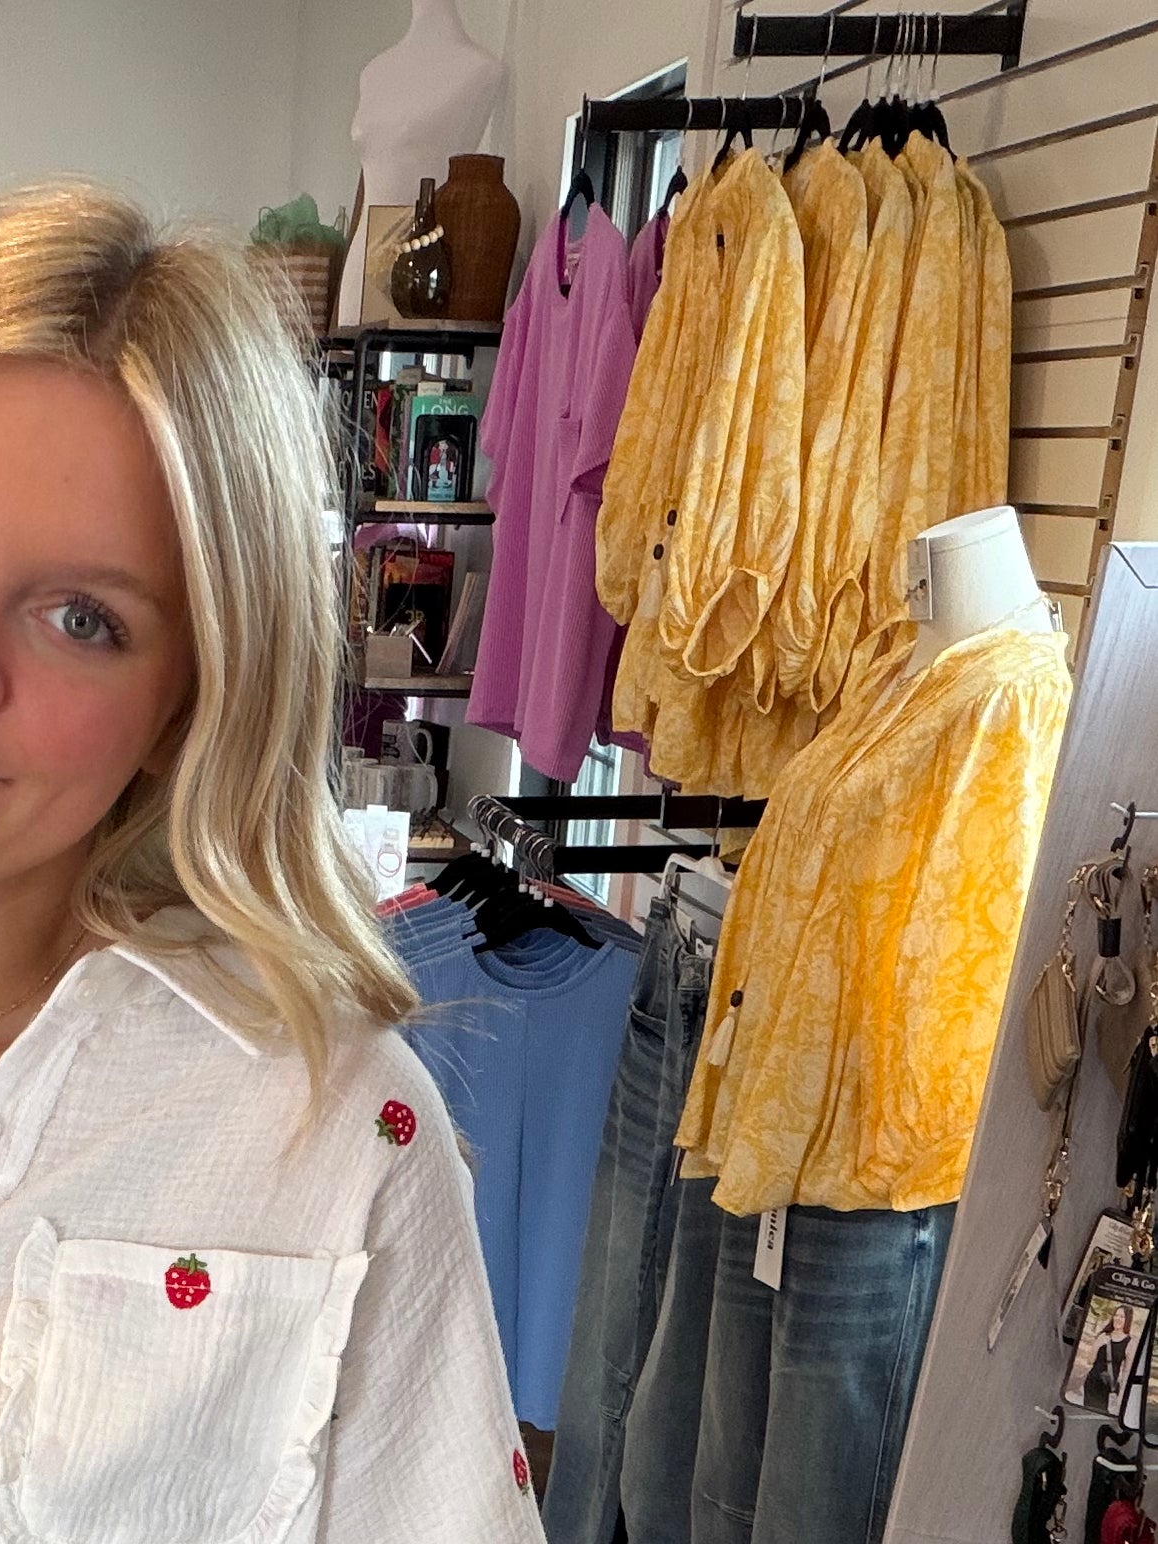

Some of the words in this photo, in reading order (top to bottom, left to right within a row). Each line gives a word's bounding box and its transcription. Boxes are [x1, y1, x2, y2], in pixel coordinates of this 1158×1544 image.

[342, 390, 379, 410] QEN
[422, 404, 468, 415] LONG
[1112, 1272, 1131, 1286] Clip
[1141, 1280, 1156, 1290] Go
